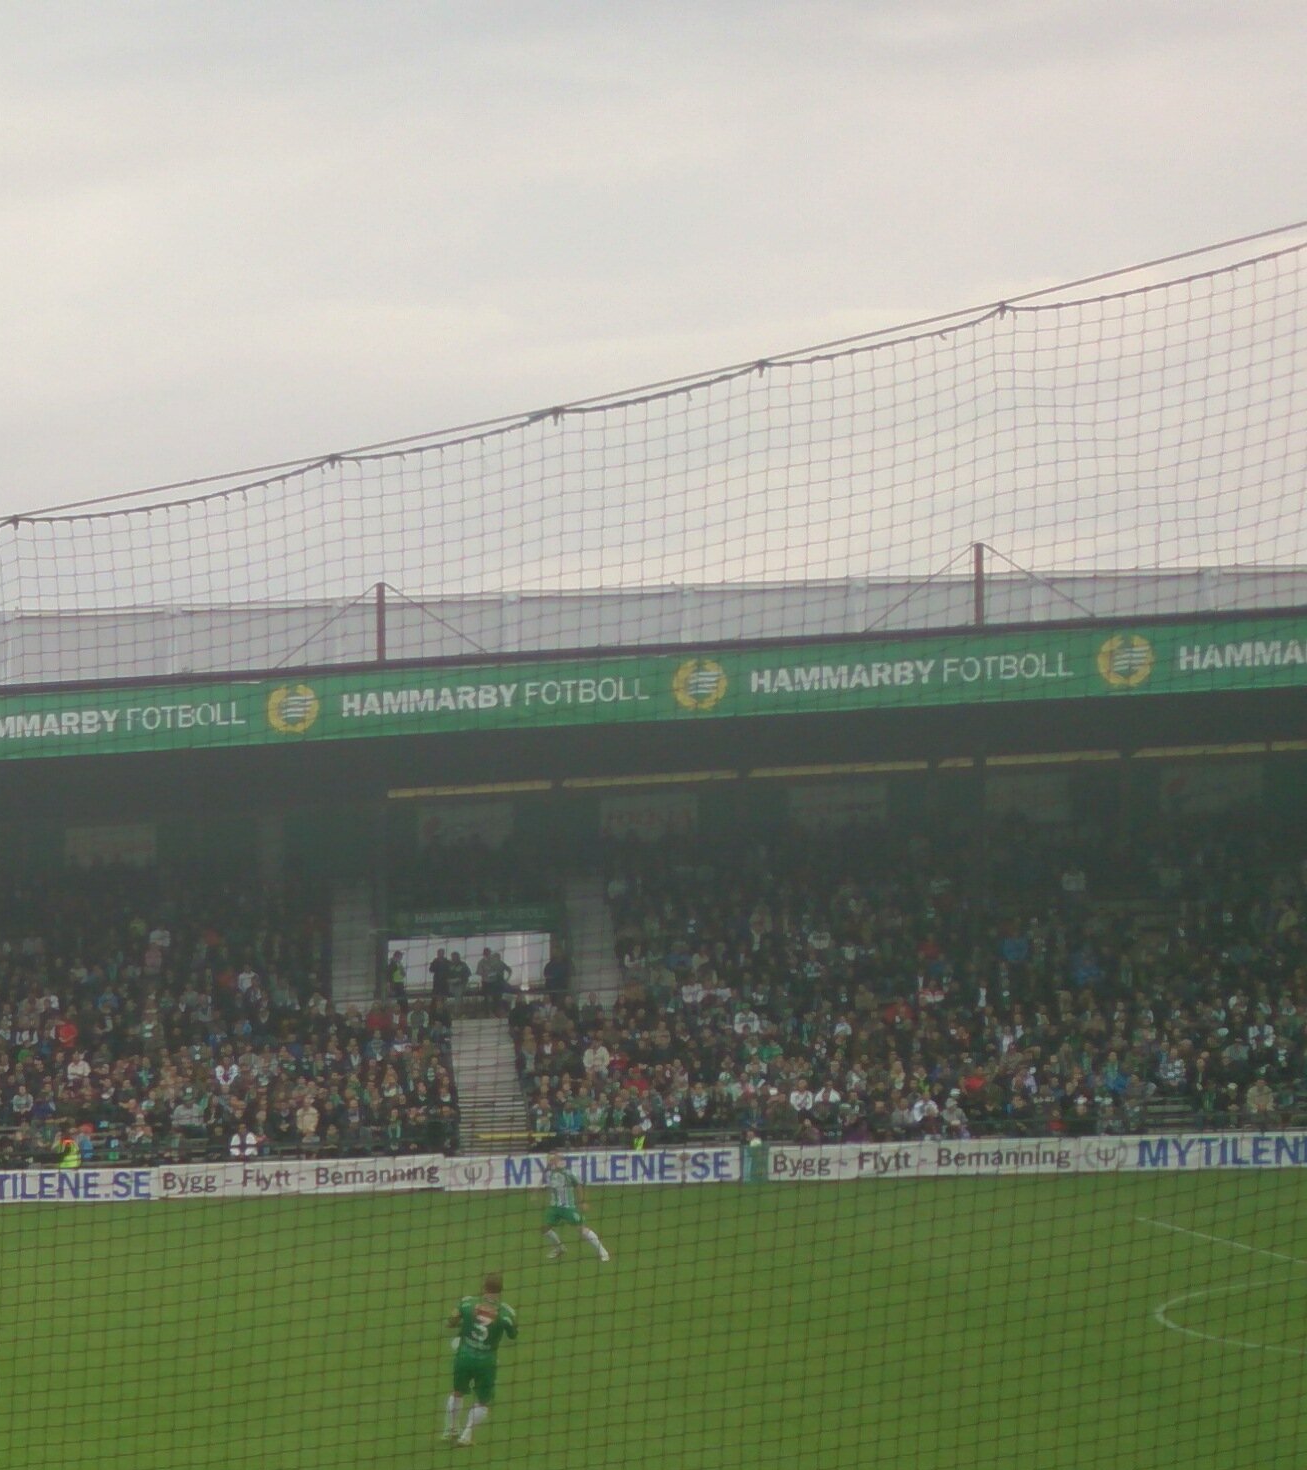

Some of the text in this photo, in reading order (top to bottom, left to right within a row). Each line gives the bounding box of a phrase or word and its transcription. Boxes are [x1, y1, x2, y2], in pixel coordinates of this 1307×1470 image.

[751, 651, 1075, 695] HAMMARBY FOTBOLL
[1179, 639, 1307, 671] HAMMA
[342, 676, 650, 718] HAMMARBY FOTBOLL
[127, 702, 246, 731] FOTBOLL
[162, 1162, 440, 1193] Bygg Flytt Bemanning
[773, 1139, 1072, 1180] Bygg Flytt Bemanning
